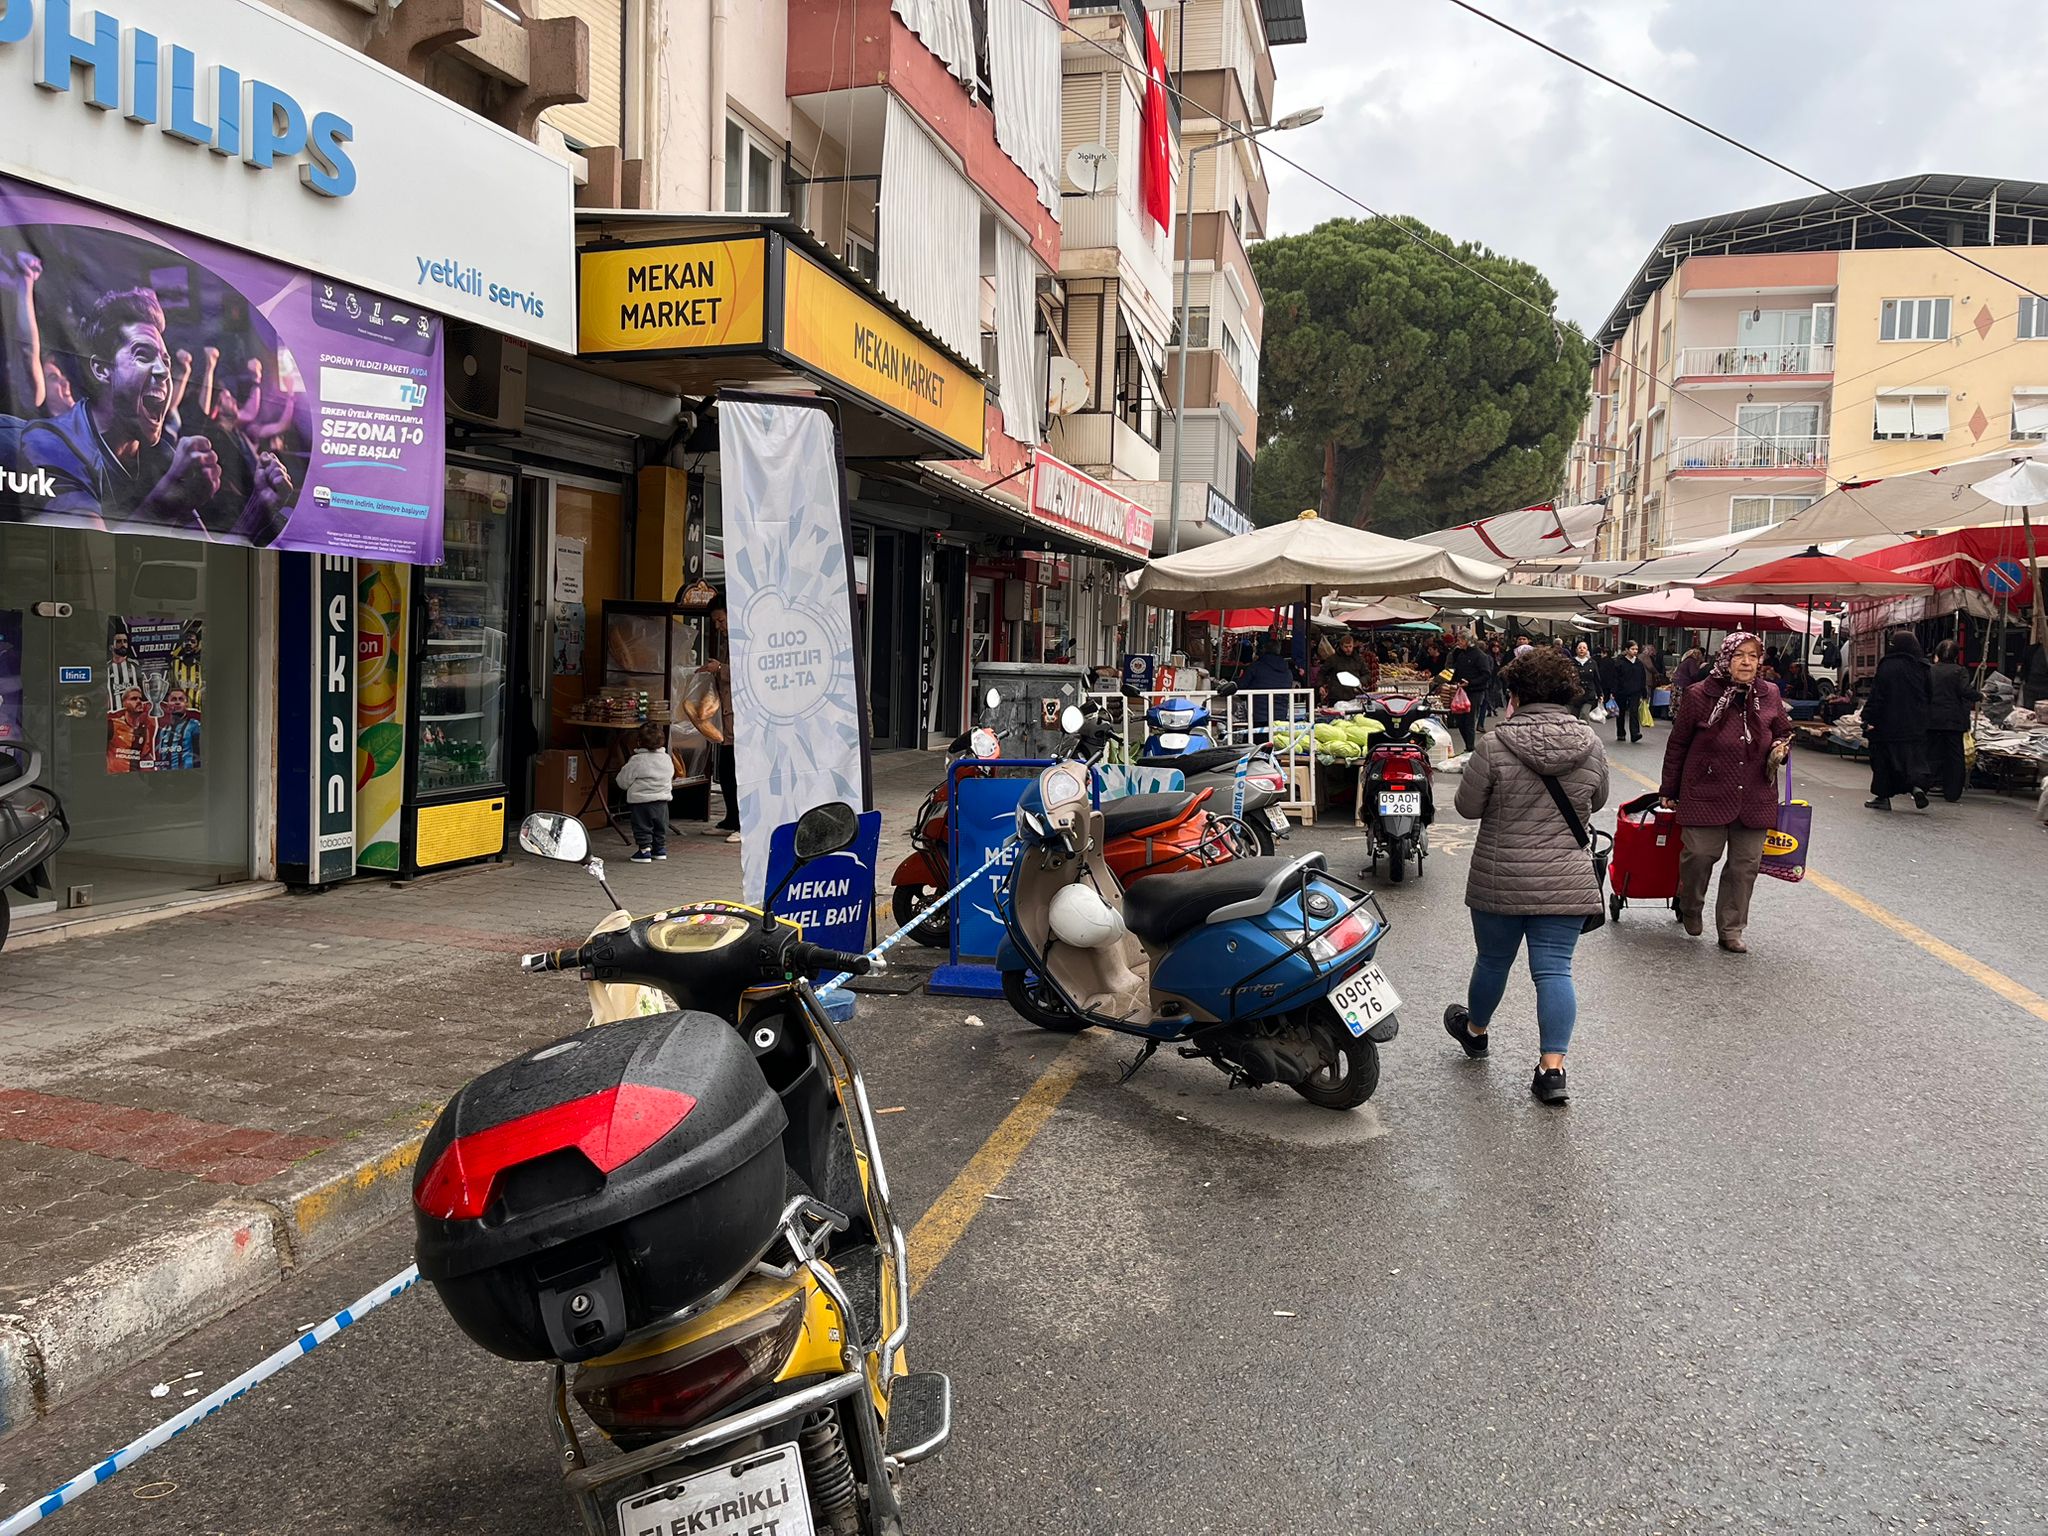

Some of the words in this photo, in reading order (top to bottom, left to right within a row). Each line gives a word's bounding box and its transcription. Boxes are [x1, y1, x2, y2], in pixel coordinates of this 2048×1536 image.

[417, 255, 482, 298] yetkili
[488, 282, 545, 319] servis
[628, 260, 714, 293] MEKAN
[620, 297, 722, 330] MARKET
[320, 353, 353, 366] SPORUN
[355, 358, 382, 370] YILDIZI
[410, 367, 427, 376] AYDA
[854, 322, 899, 383] MEKAN
[901, 351, 945, 409] MARKET
[400, 385, 426, 405] TL!
[321, 407, 347, 416] ERKEN
[347, 408, 373, 419] ÜYELİK
[374, 413, 423, 425] FIRSATLARIYLA
[321, 419, 396, 443] SEZONA
[397, 426, 424, 445] 1-0
[321, 439, 356, 456] ÖNDE
[358, 444, 401, 460] BAŞLA!
[331, 495, 354, 506] Hemen
[376, 501, 400, 513] izlemeye
[1078, 481, 1104, 530] AUTO
[65, 668, 87, 680] İtiniz
[1381, 794, 1394, 803] 09
[1393, 804, 1413, 813] 266
[787, 878, 850, 902] MEKAN
[824, 899, 863, 926] BAYİ
[1335, 968, 1385, 1010] 09CFH
[1359, 997, 1382, 1020] 76
[639, 1478, 790, 1536] ELEKTRİKLİ
